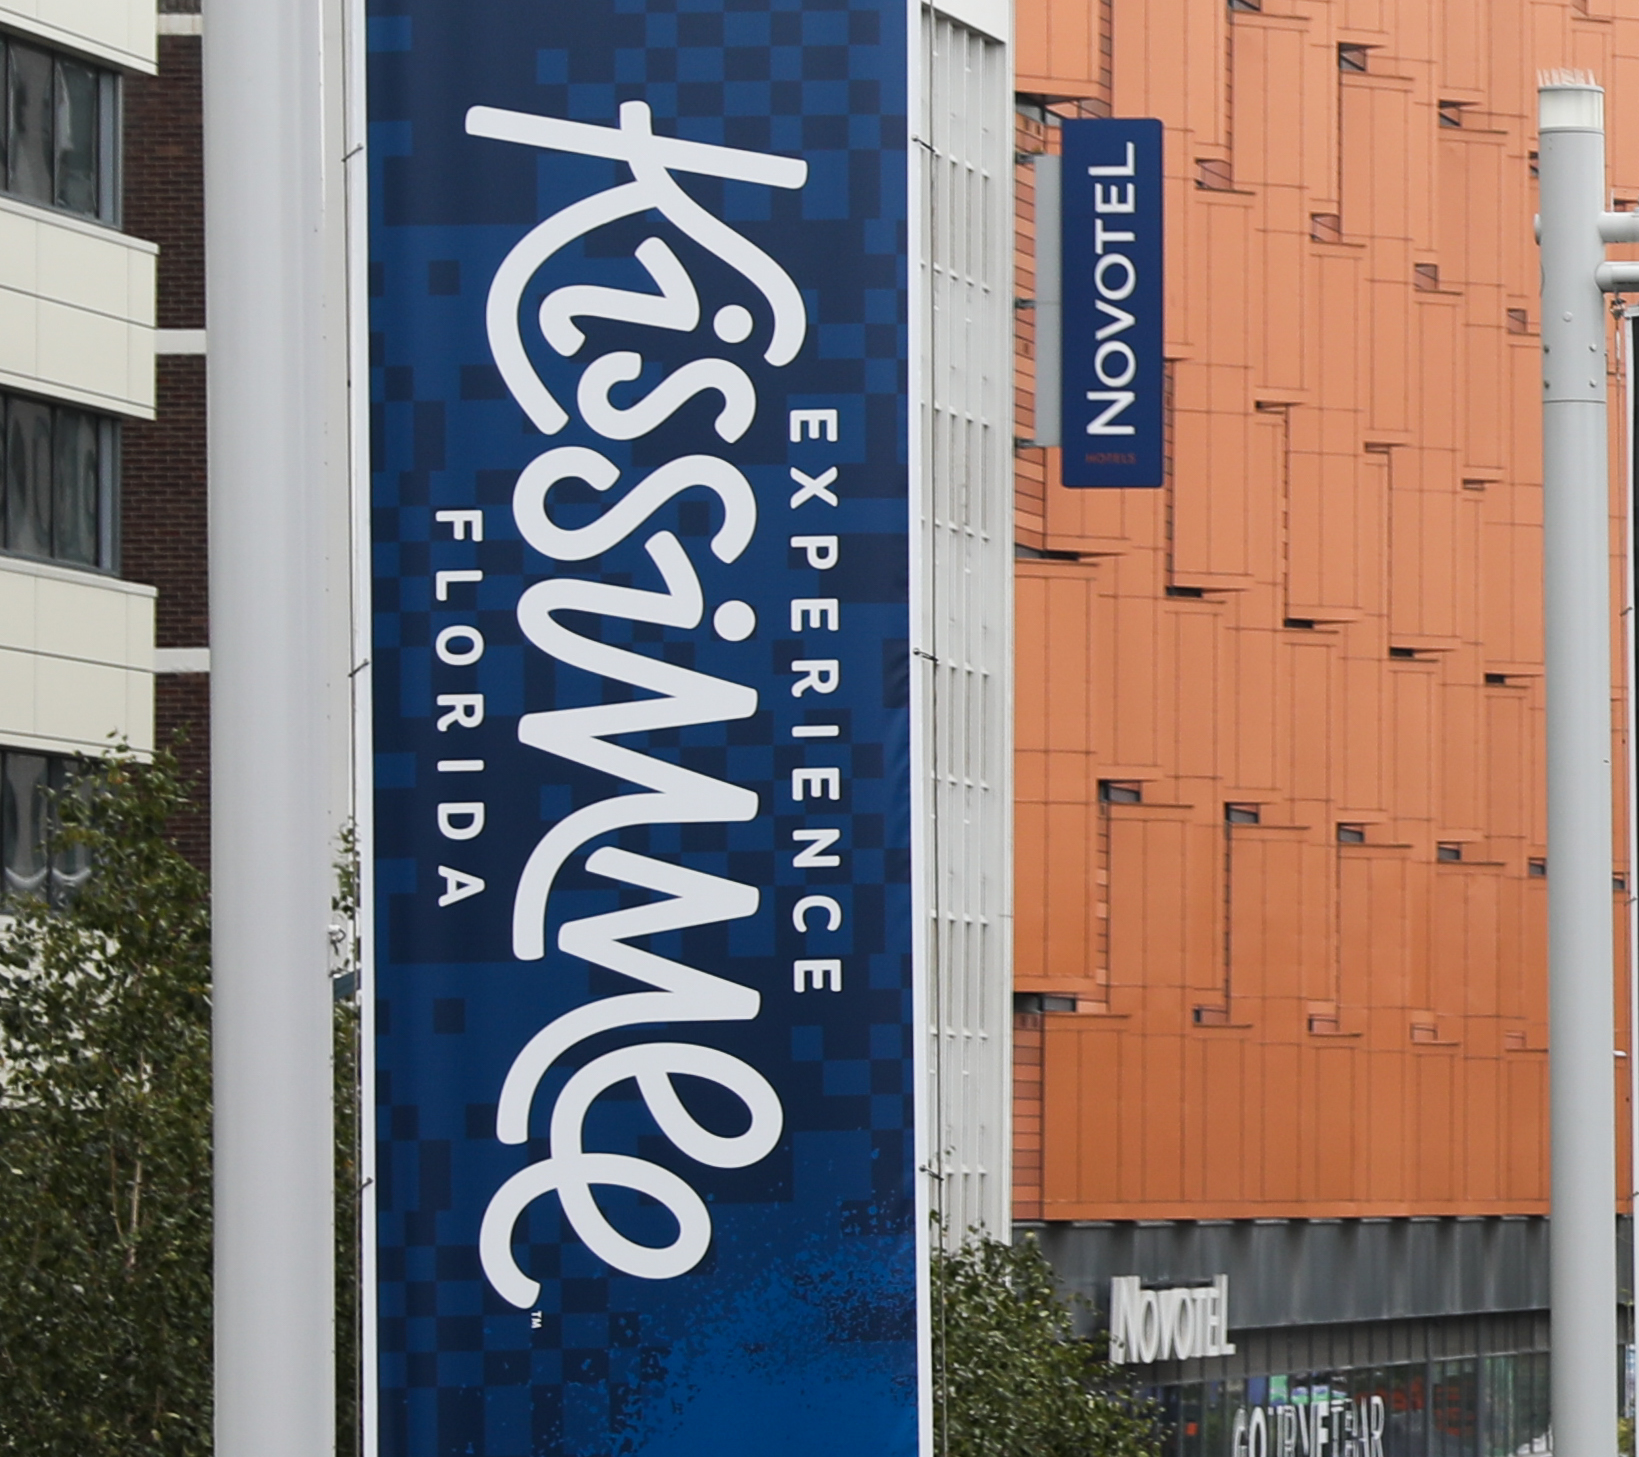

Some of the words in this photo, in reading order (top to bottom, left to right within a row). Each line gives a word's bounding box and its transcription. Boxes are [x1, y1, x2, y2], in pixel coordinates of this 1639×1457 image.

[1086, 139, 1138, 439] NOVOTEL
[433, 507, 488, 910] FLORIDA
[786, 404, 844, 996] EXPERIENCE
[1109, 1274, 1236, 1364] NOVOTEL
